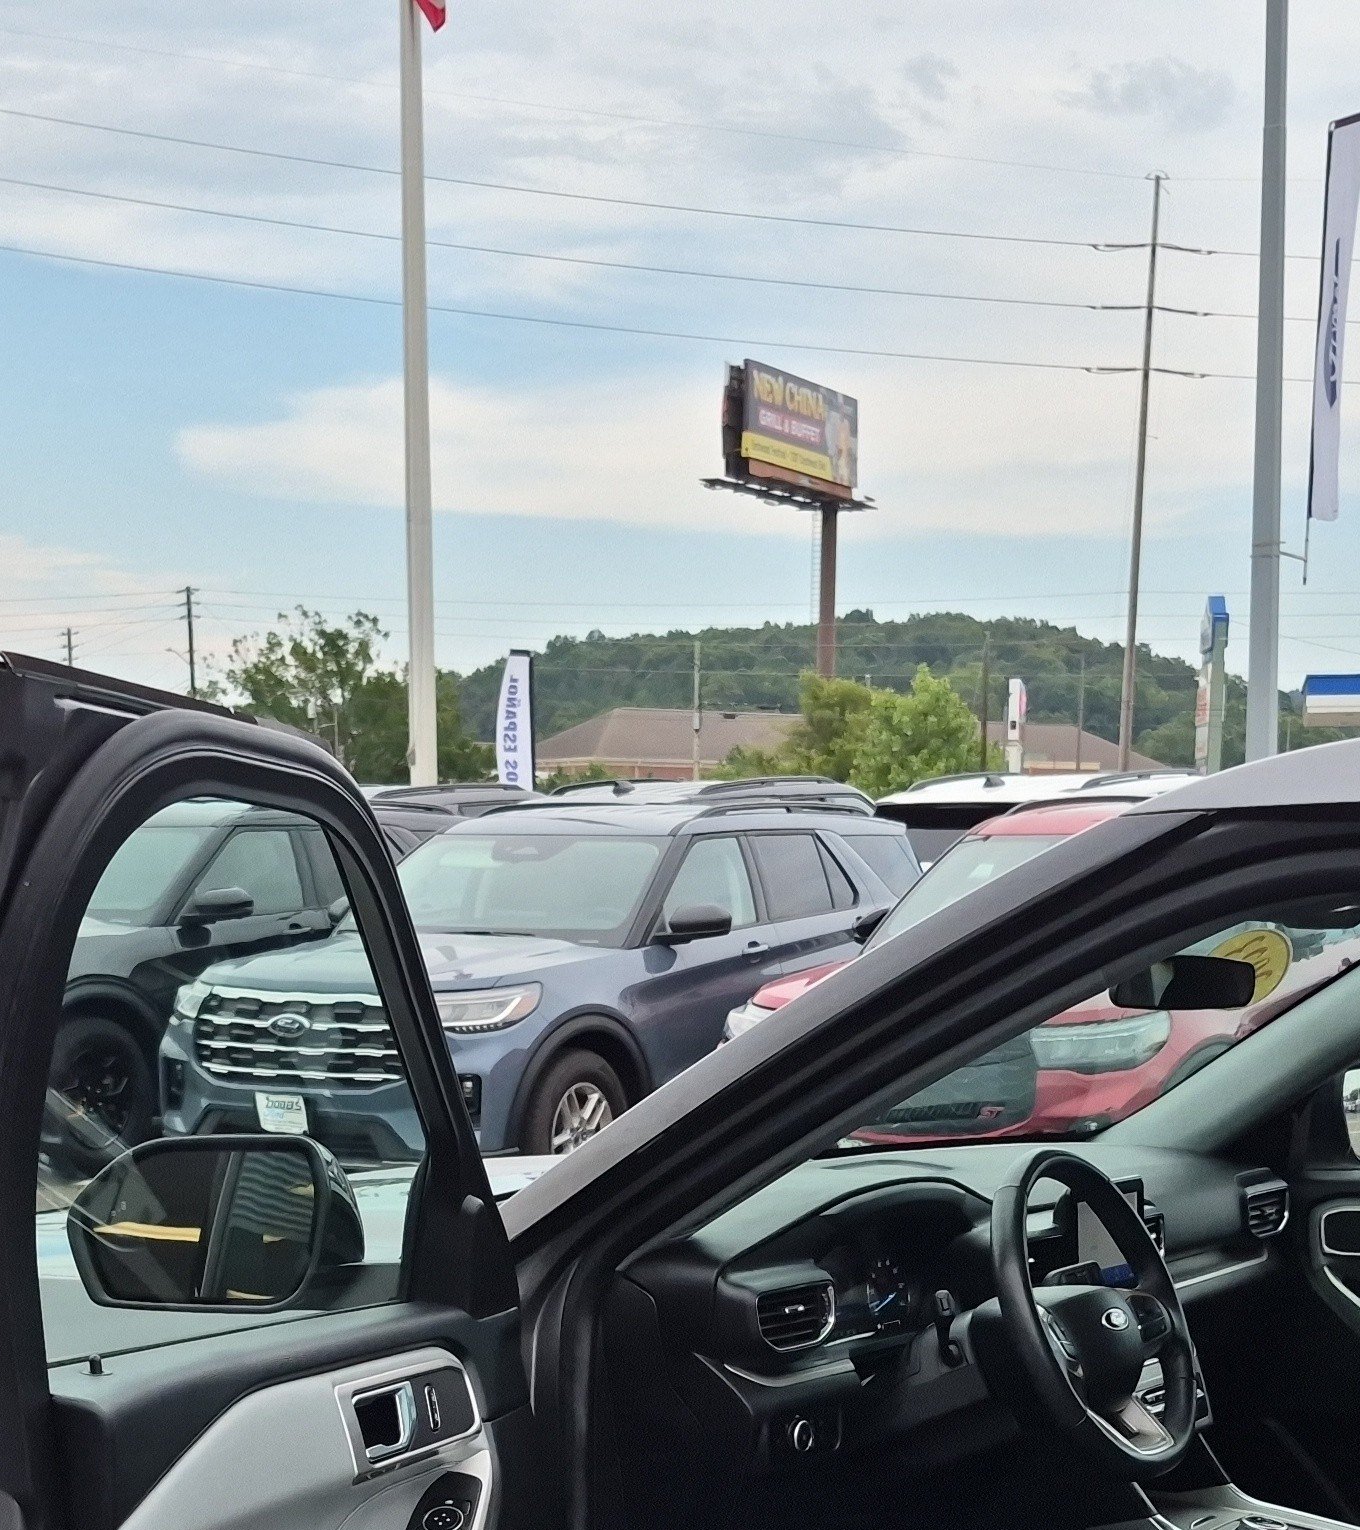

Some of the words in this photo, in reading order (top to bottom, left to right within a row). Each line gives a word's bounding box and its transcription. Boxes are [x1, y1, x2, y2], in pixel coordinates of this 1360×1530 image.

[753, 370, 784, 406] NEW
[785, 382, 825, 420] CHINA
[976, 1106, 1006, 1120] ST
